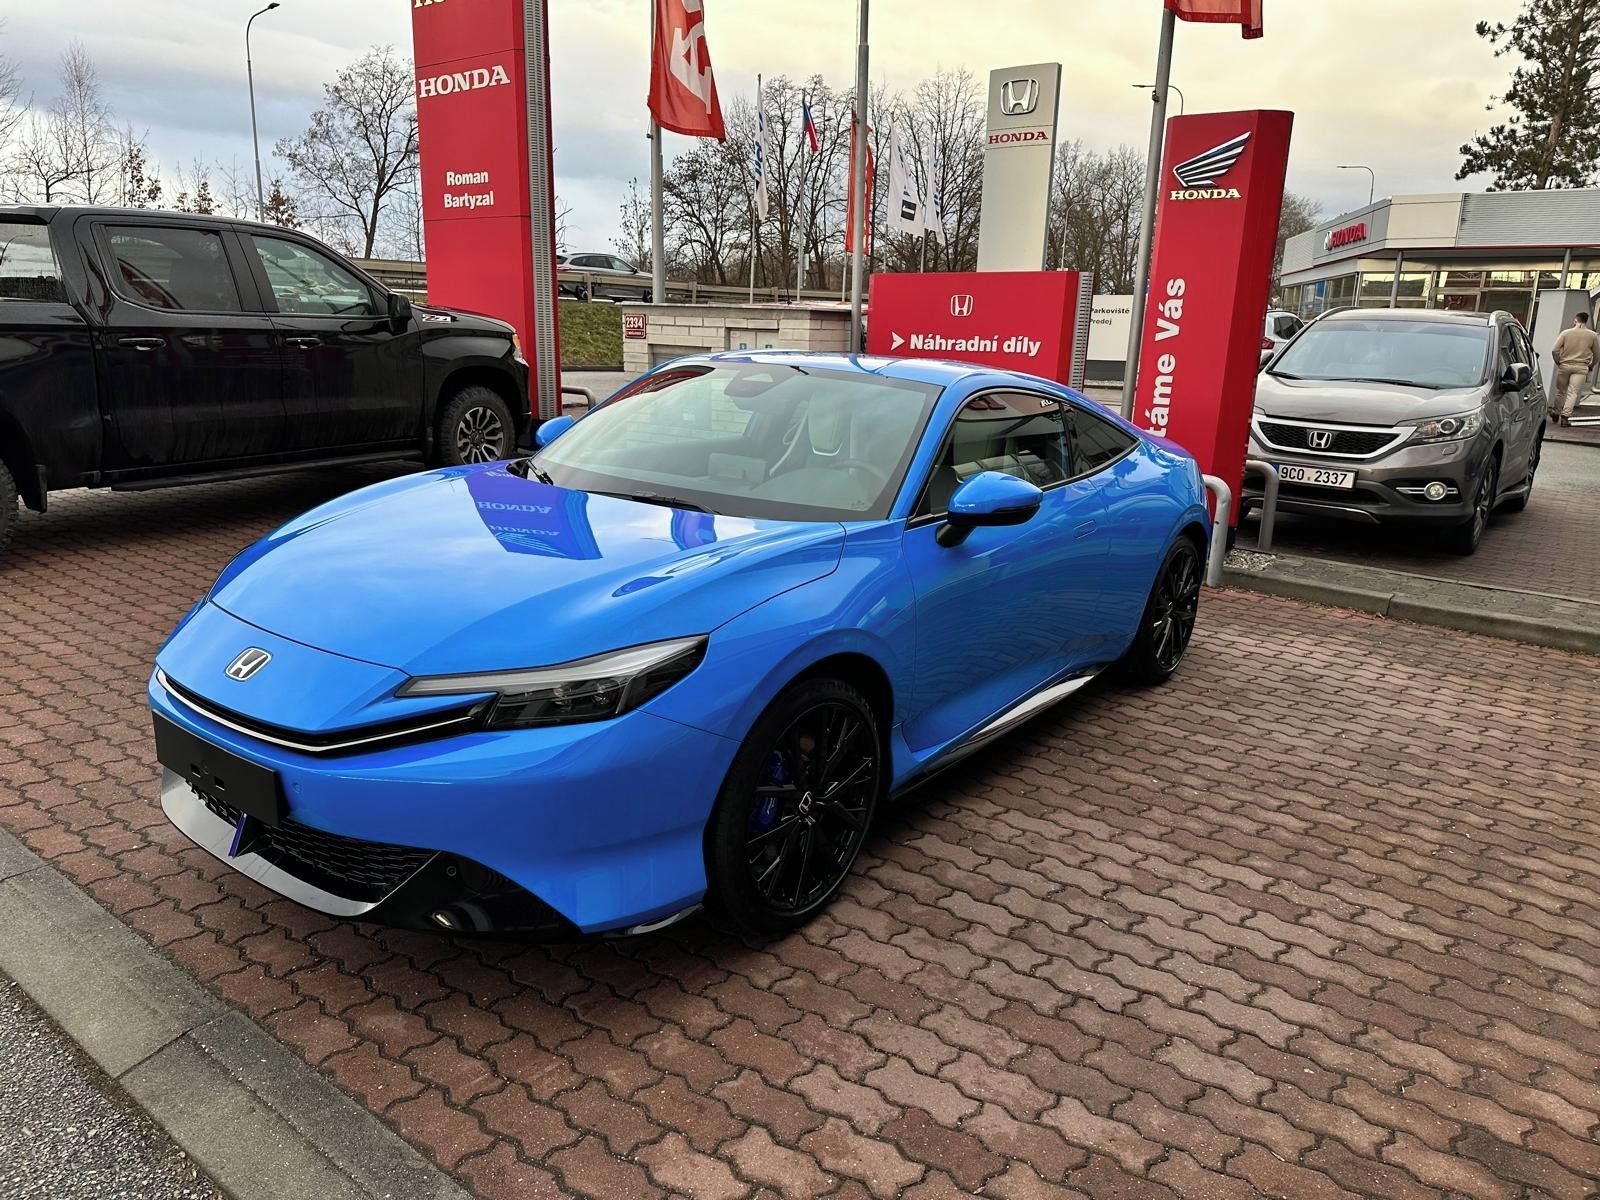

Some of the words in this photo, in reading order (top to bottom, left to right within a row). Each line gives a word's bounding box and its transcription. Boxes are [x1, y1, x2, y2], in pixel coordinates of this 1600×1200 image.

[419, 65, 510, 98] HONDA
[988, 131, 1048, 144] HONDA
[446, 171, 488, 186] Roman
[444, 191, 494, 209] Bartyzal
[1170, 189, 1241, 200] HONDA
[1155, 278, 1186, 341] Vás
[626, 317, 643, 328] 2334
[910, 334, 998, 352] Náhradní
[1003, 336, 1041, 356] díly
[1314, 471, 1347, 485] 2337
